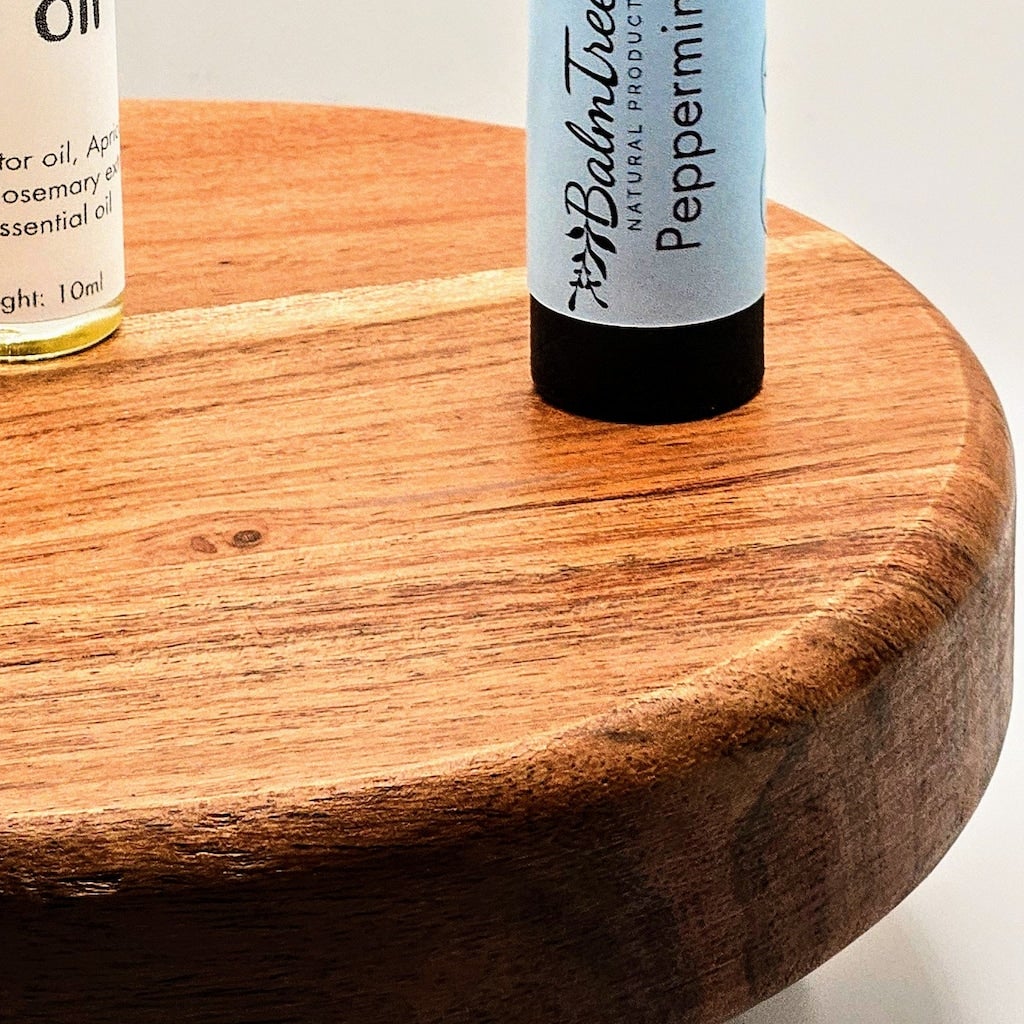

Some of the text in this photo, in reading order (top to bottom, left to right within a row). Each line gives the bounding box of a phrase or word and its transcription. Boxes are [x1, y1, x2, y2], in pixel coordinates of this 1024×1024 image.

[42, 140, 78, 167] oil,
[627, 123, 644, 232] NATURAL
[94, 190, 113, 220] oil
[60, 271, 105, 304] 10ml
